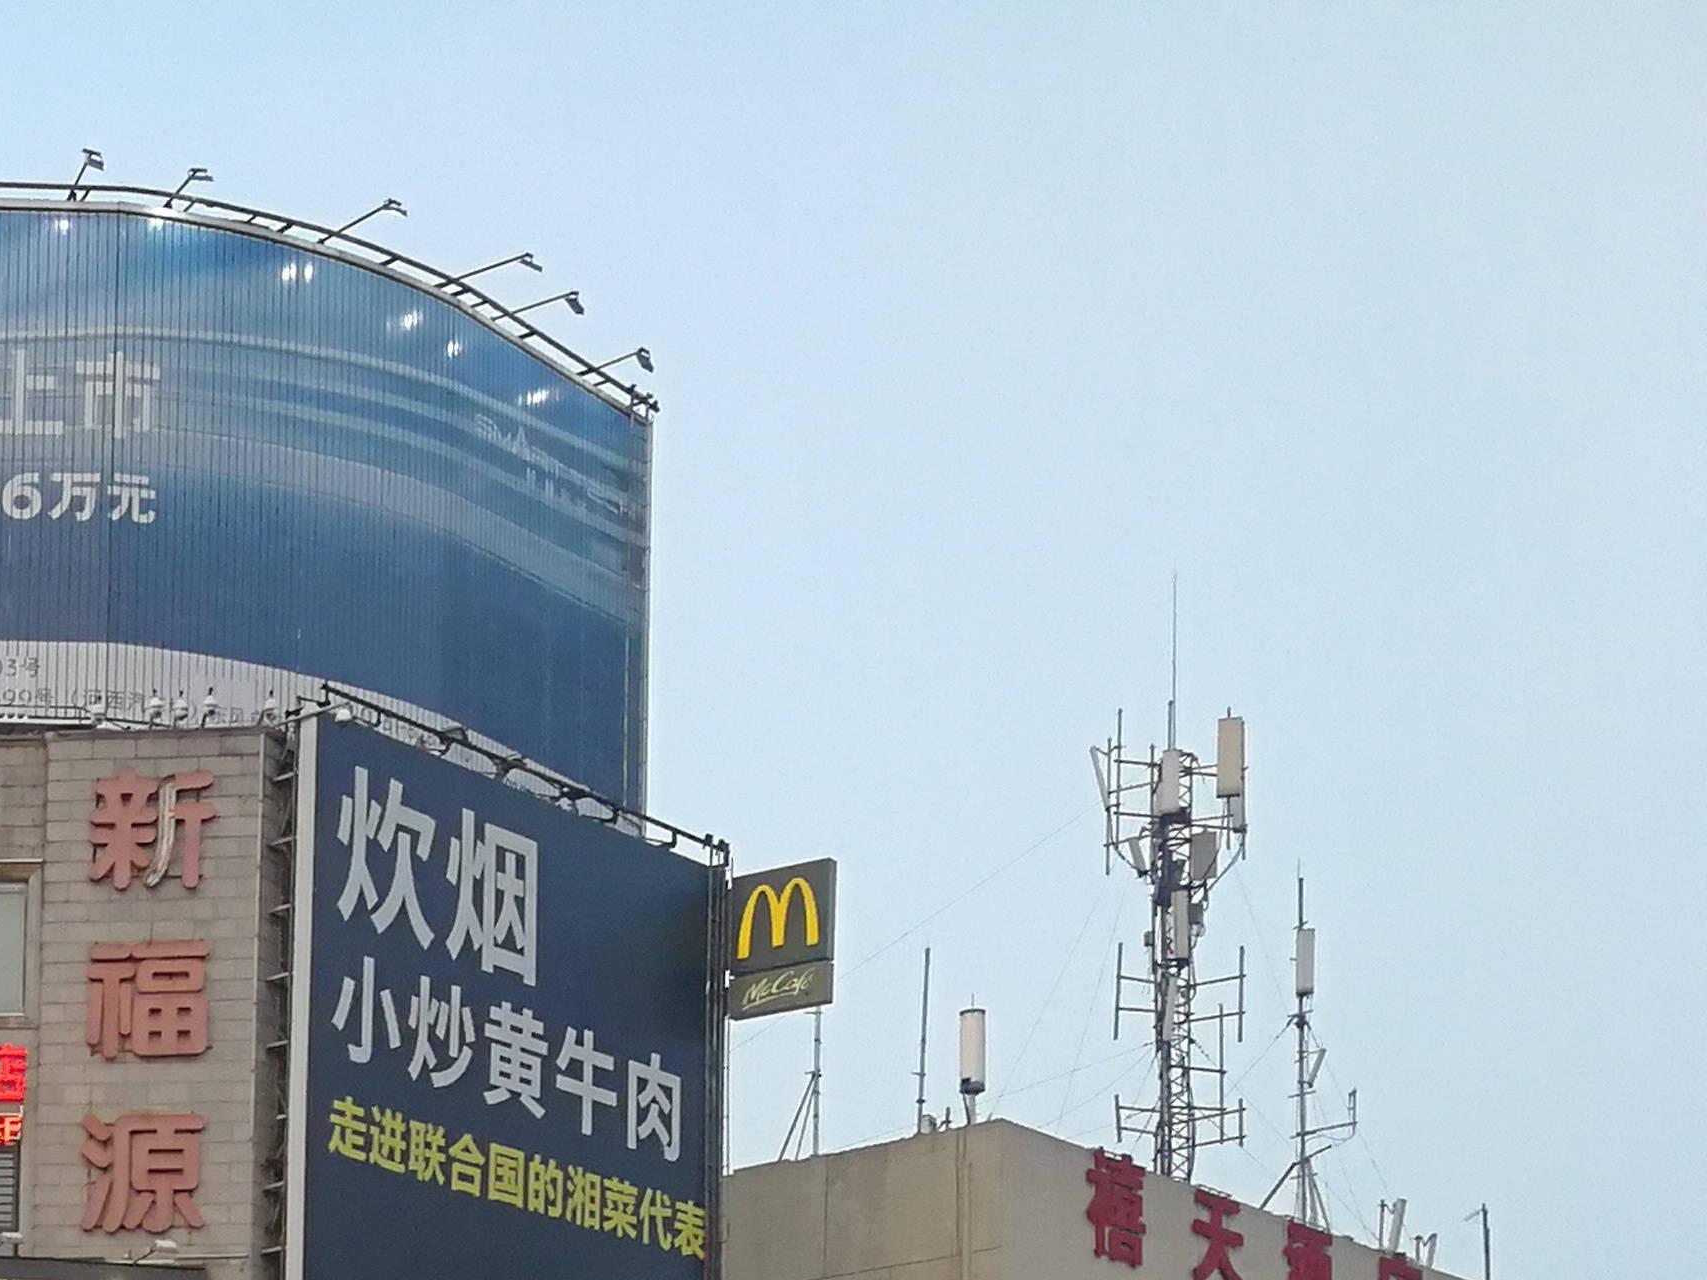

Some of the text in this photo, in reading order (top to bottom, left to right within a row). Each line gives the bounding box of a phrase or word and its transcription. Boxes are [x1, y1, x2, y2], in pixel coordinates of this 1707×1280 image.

[336, 766, 539, 987] 炊烟
[82, 769, 218, 1236] 新福源
[332, 955, 683, 1163] 小炒黄牛肉
[328, 1096, 708, 1261] 走进联合国的湘菜代表
